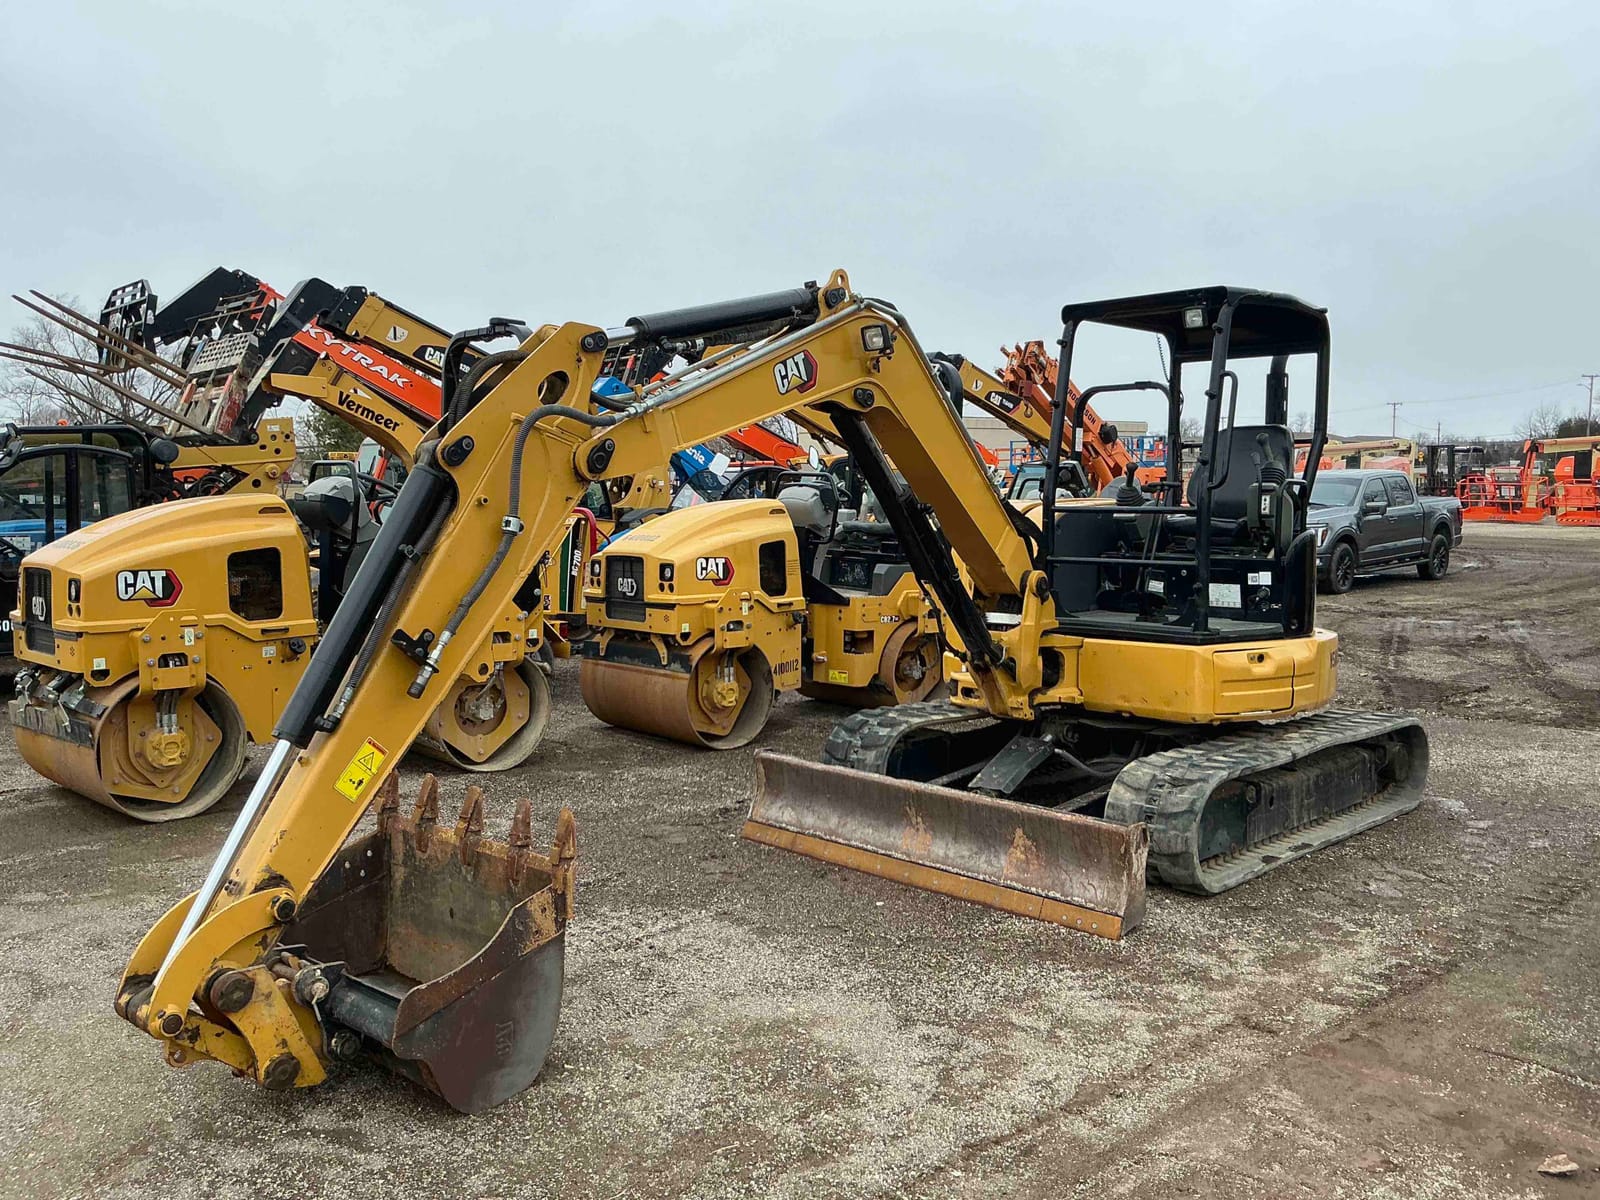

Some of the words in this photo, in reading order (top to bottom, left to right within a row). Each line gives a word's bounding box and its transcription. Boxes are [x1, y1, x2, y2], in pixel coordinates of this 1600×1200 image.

[301, 323, 412, 389] KYTRAK
[774, 351, 808, 394] CAT
[338, 390, 400, 432] Vermeer
[696, 557, 726, 580] CAT
[117, 570, 166, 600] CAT
[617, 577, 632, 593] CAT
[32, 596, 44, 616] CAT
